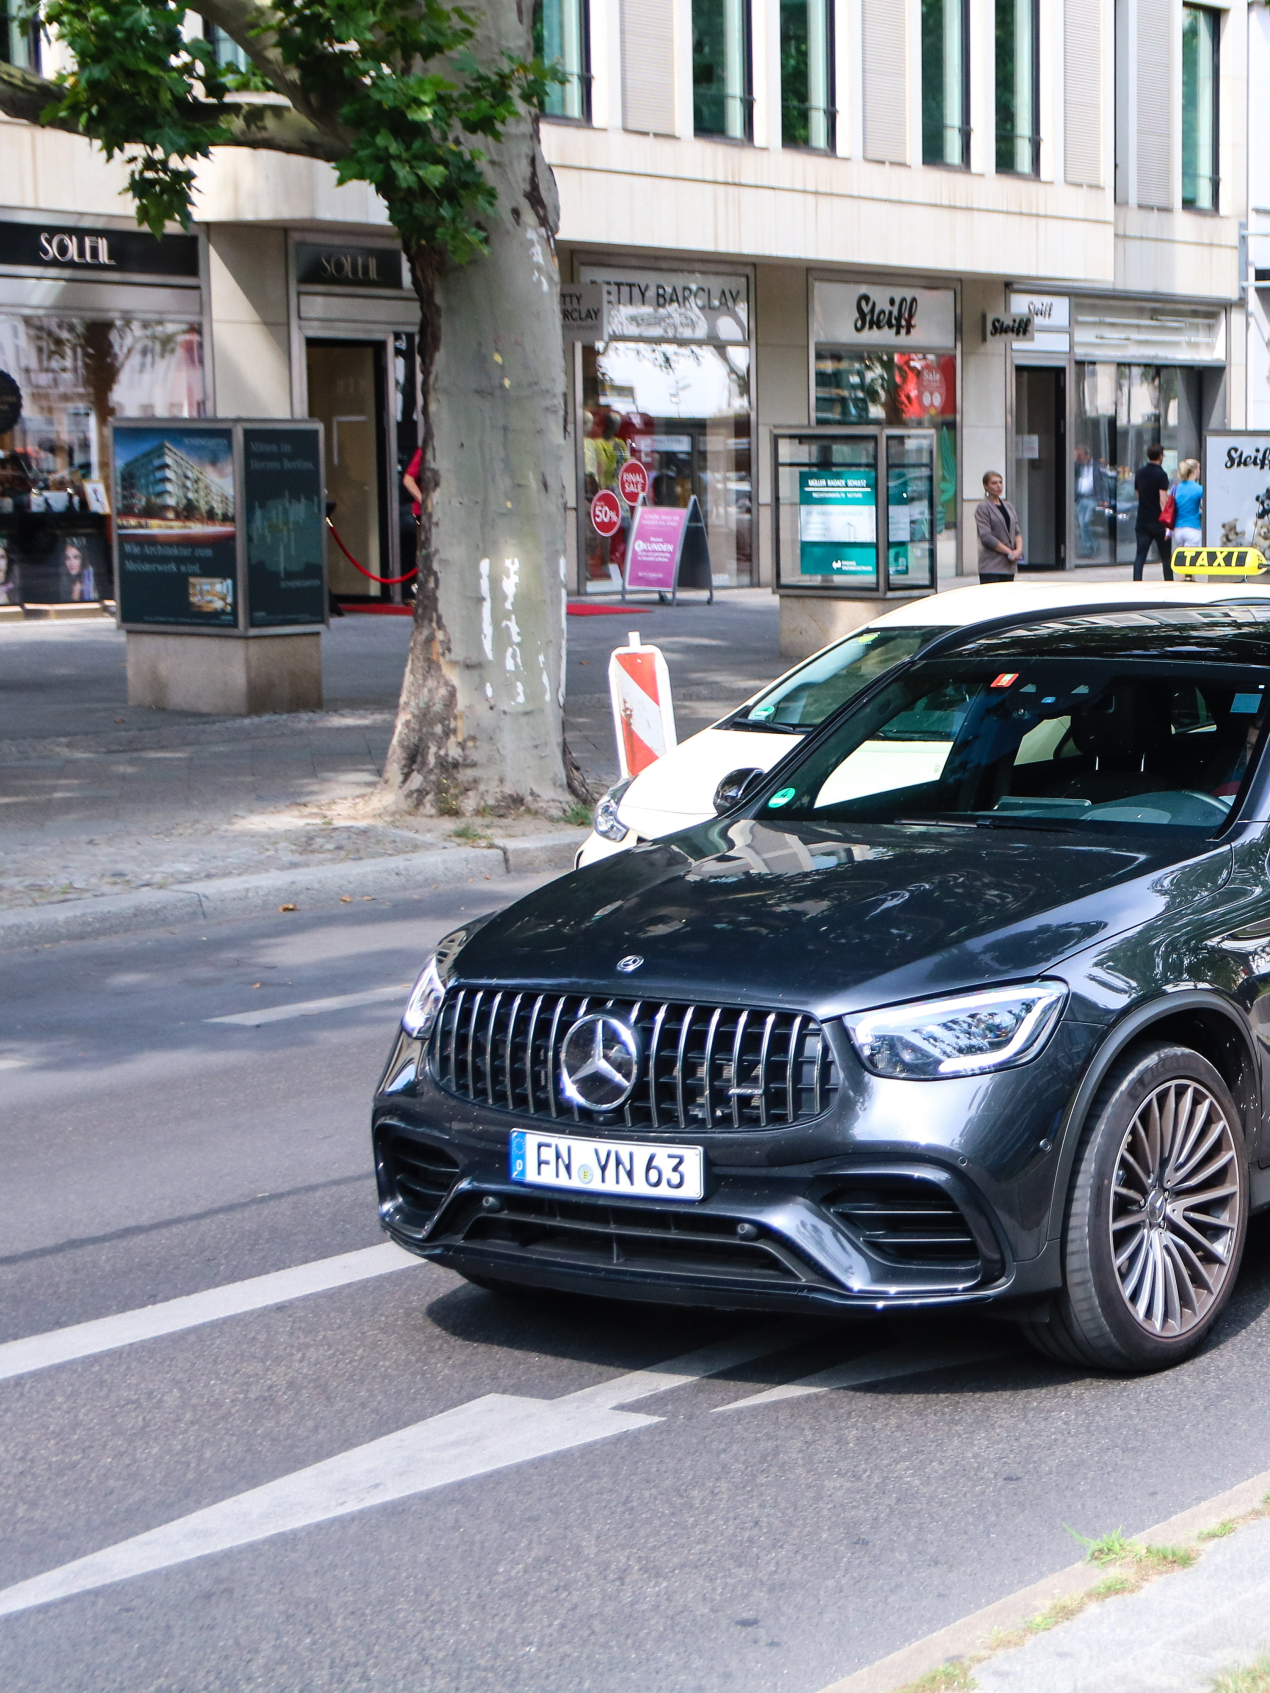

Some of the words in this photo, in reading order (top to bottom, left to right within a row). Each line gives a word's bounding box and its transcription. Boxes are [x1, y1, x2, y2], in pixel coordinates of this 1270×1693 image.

[39, 232, 117, 265] SOLEIL
[320, 254, 383, 282] SOLEIL
[656, 284, 740, 311] BARCLAY
[854, 292, 918, 337] Steiff
[989, 316, 1031, 337] Steiff
[623, 473, 643, 484] FINAL
[594, 505, 618, 523] 50%
[1183, 551, 1239, 567] TAXI
[537, 1141, 573, 1180] FN
[594, 1147, 635, 1187] YN
[644, 1152, 685, 1189] 63
